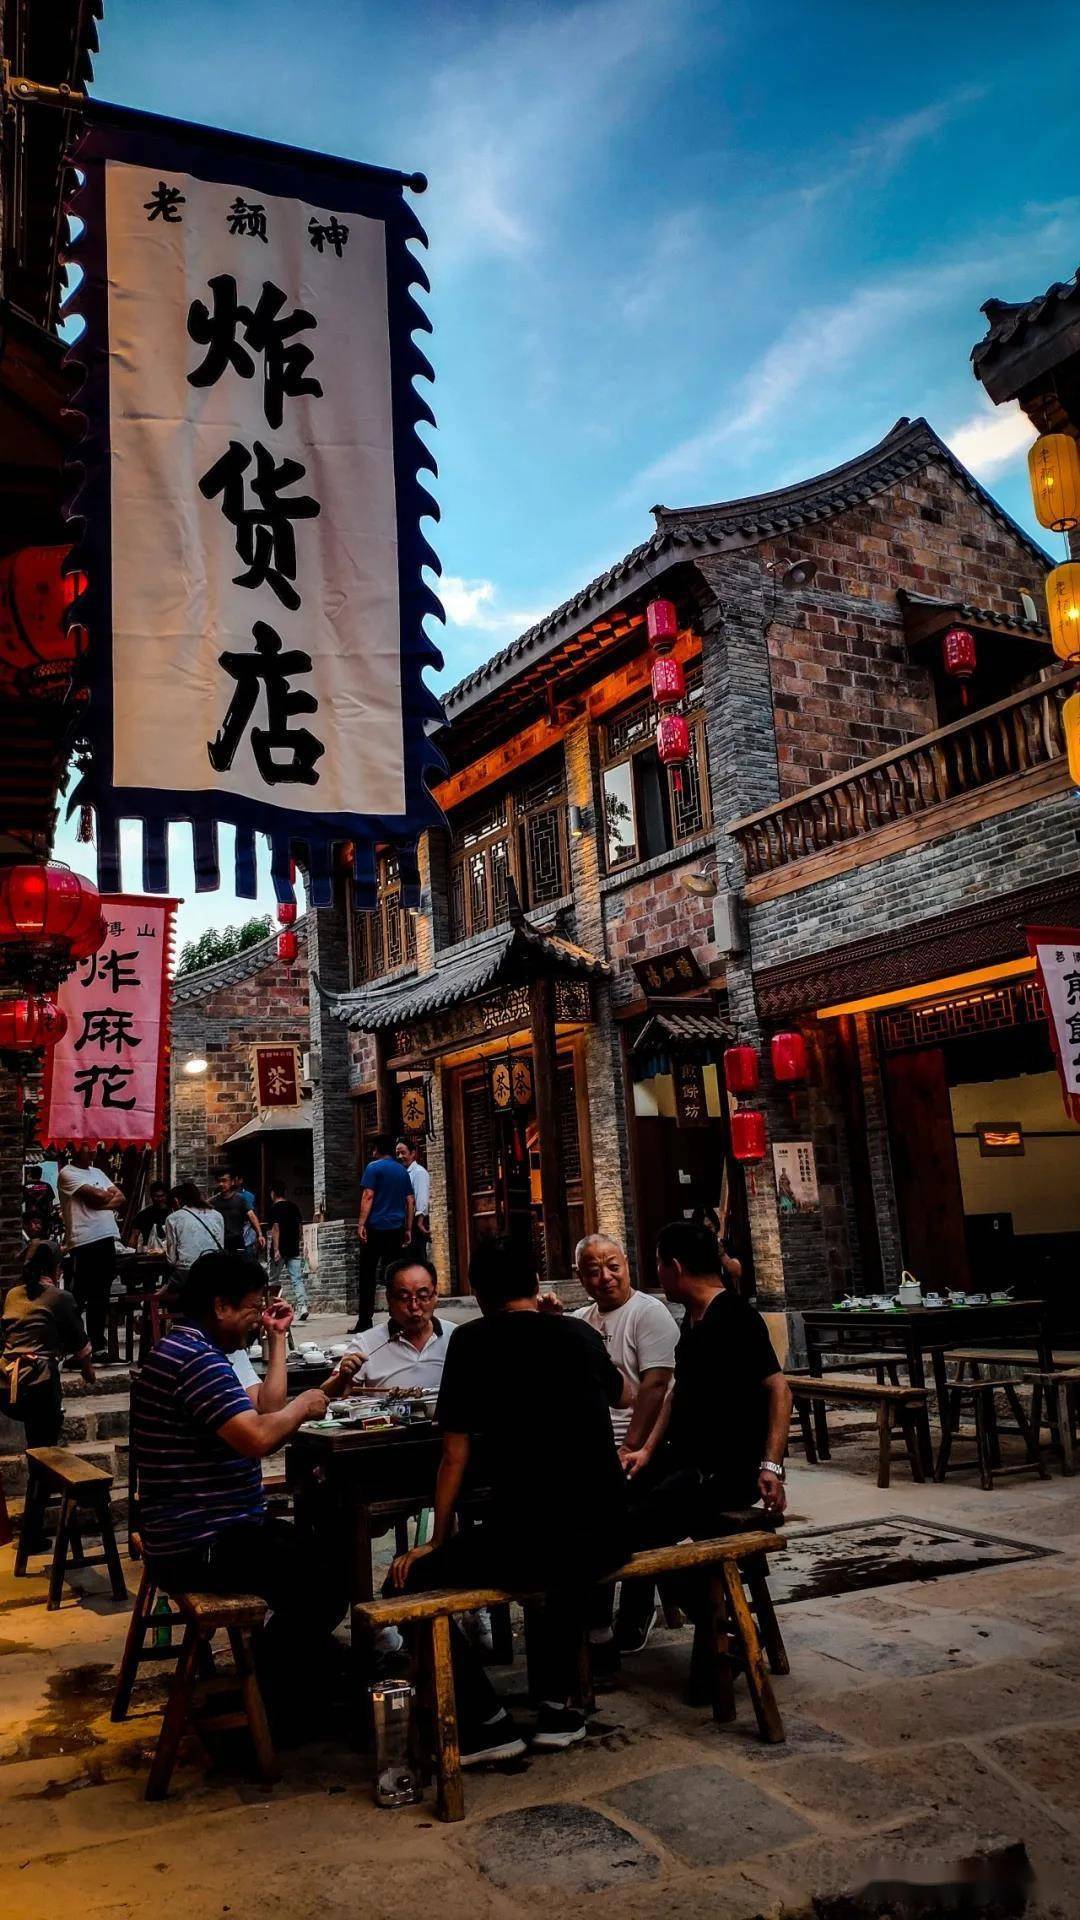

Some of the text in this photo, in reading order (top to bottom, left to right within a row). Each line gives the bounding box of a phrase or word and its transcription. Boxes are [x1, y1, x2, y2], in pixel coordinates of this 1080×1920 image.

[186, 273, 326, 788] 炸货店
[74, 949, 142, 1110] 炸麻花
[265, 1065, 296, 1096] 茶
[494, 1072, 510, 1098] 茶
[512, 1071, 531, 1098] 茶
[404, 1098, 424, 1120] 茶
